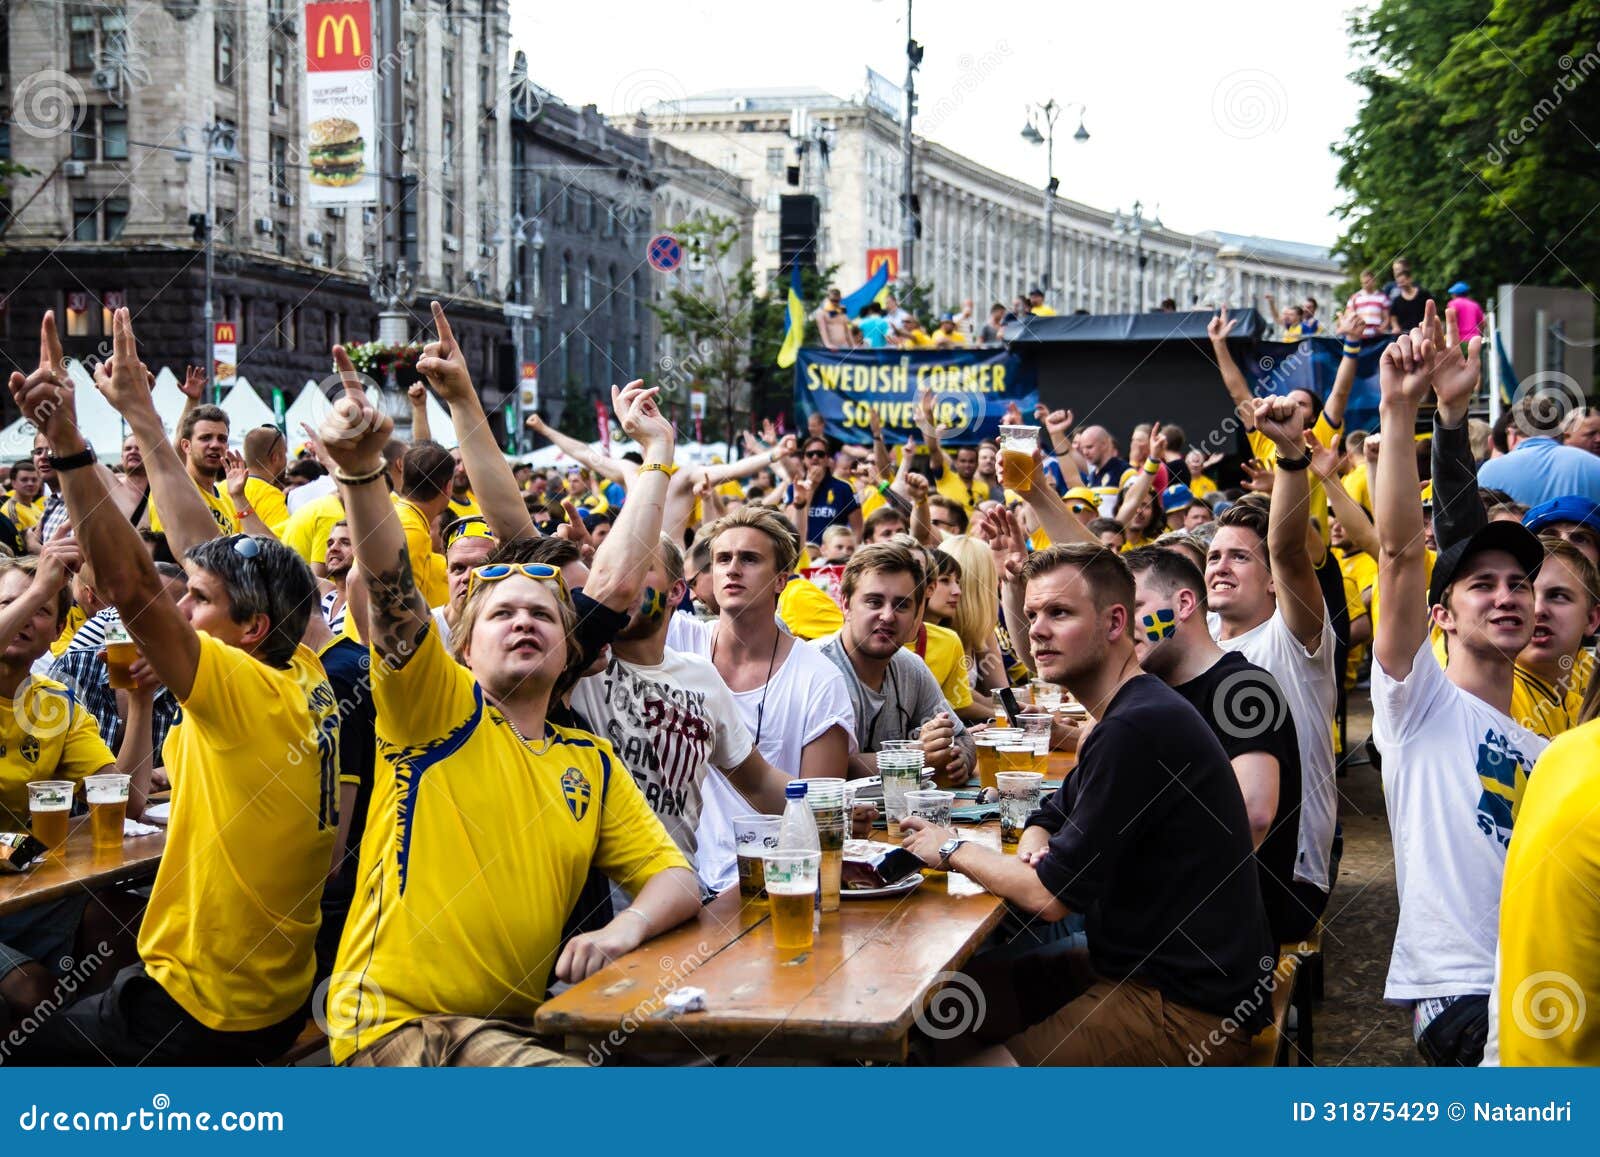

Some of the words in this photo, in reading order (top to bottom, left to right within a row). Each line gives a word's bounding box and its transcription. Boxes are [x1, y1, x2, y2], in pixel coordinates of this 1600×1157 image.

[807, 363, 908, 392] SWEDISH
[917, 364, 1006, 392] CORNER
[842, 400, 968, 428] SOUVEIRS
[808, 507, 836, 517] EDEN
[607, 718, 660, 771] SAN
